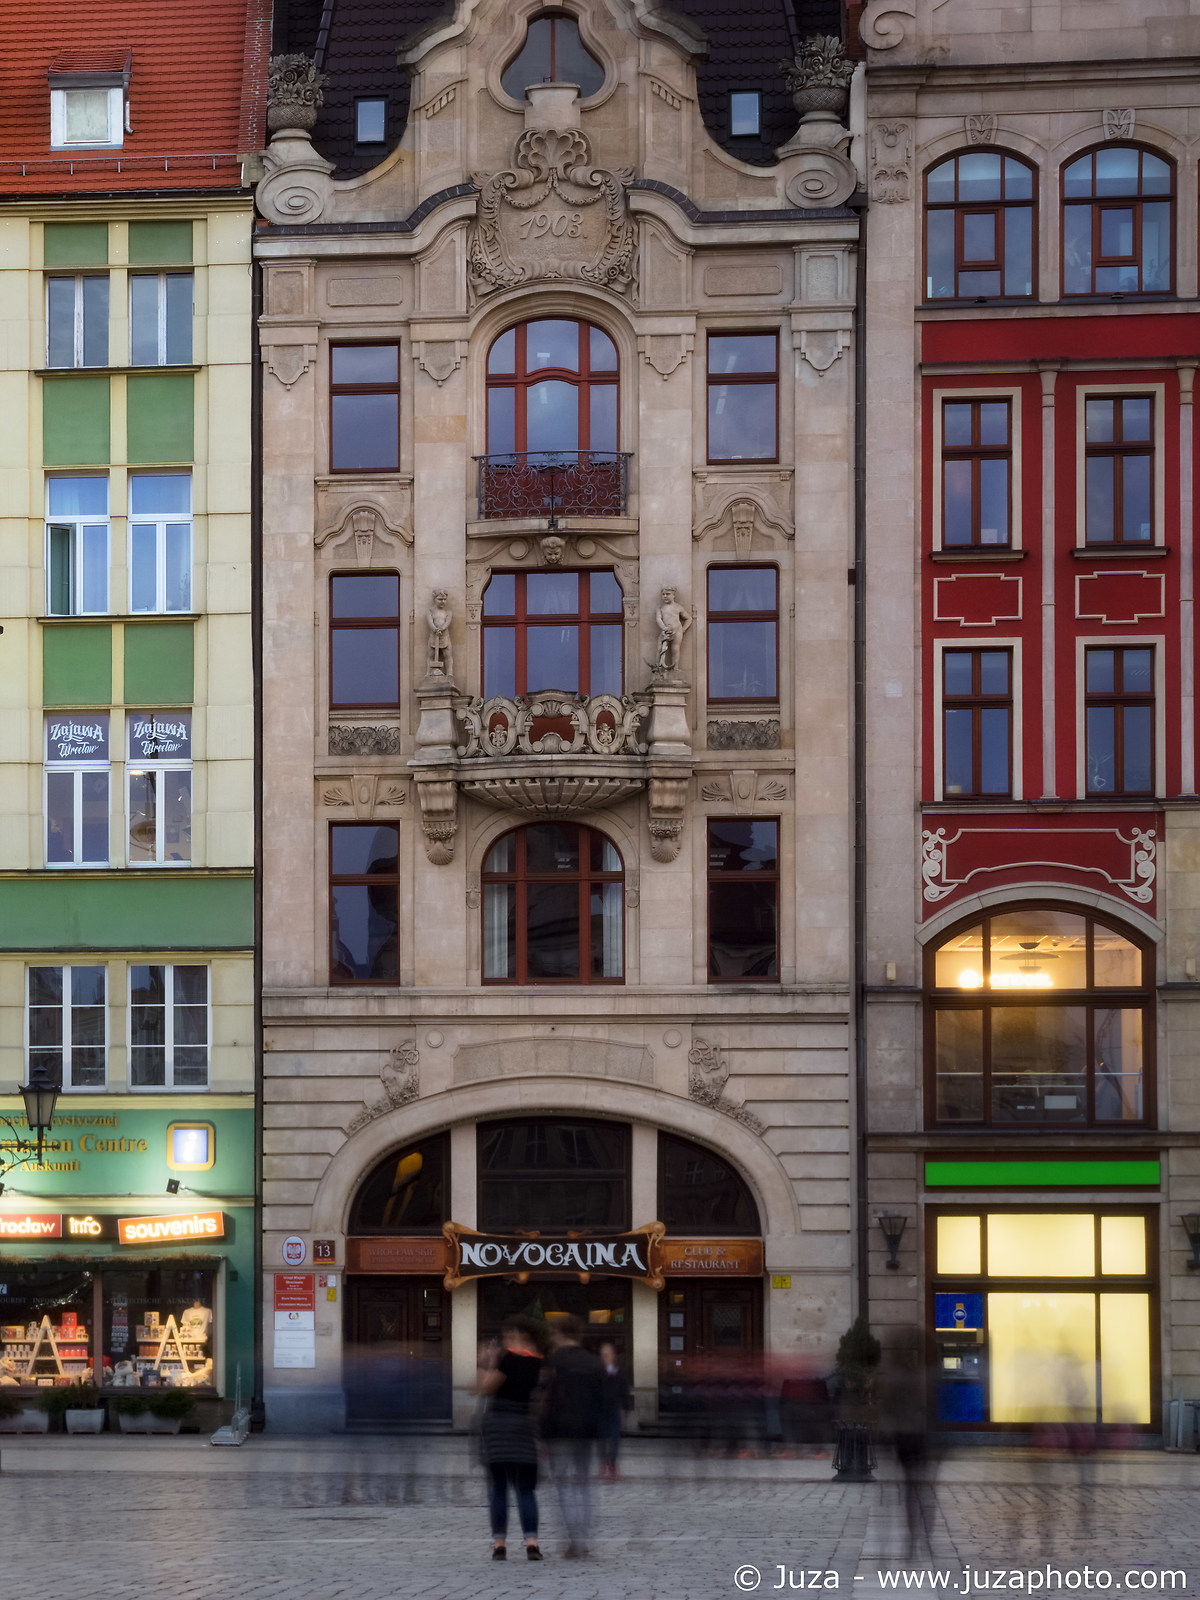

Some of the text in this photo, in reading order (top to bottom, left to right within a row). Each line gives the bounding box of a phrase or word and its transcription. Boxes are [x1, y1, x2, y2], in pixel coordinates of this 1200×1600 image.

[79, 1135, 148, 1153] Centre
[19, 1158, 80, 1172] Auskunft
[69, 1216, 101, 1234] info
[125, 1215, 217, 1239] souvenirs
[317, 1245, 331, 1257] 13
[459, 1242, 647, 1270] NOVOCAINA
[684, 1247, 727, 1256] CLUB &
[671, 1260, 740, 1269] RESTAURANT
